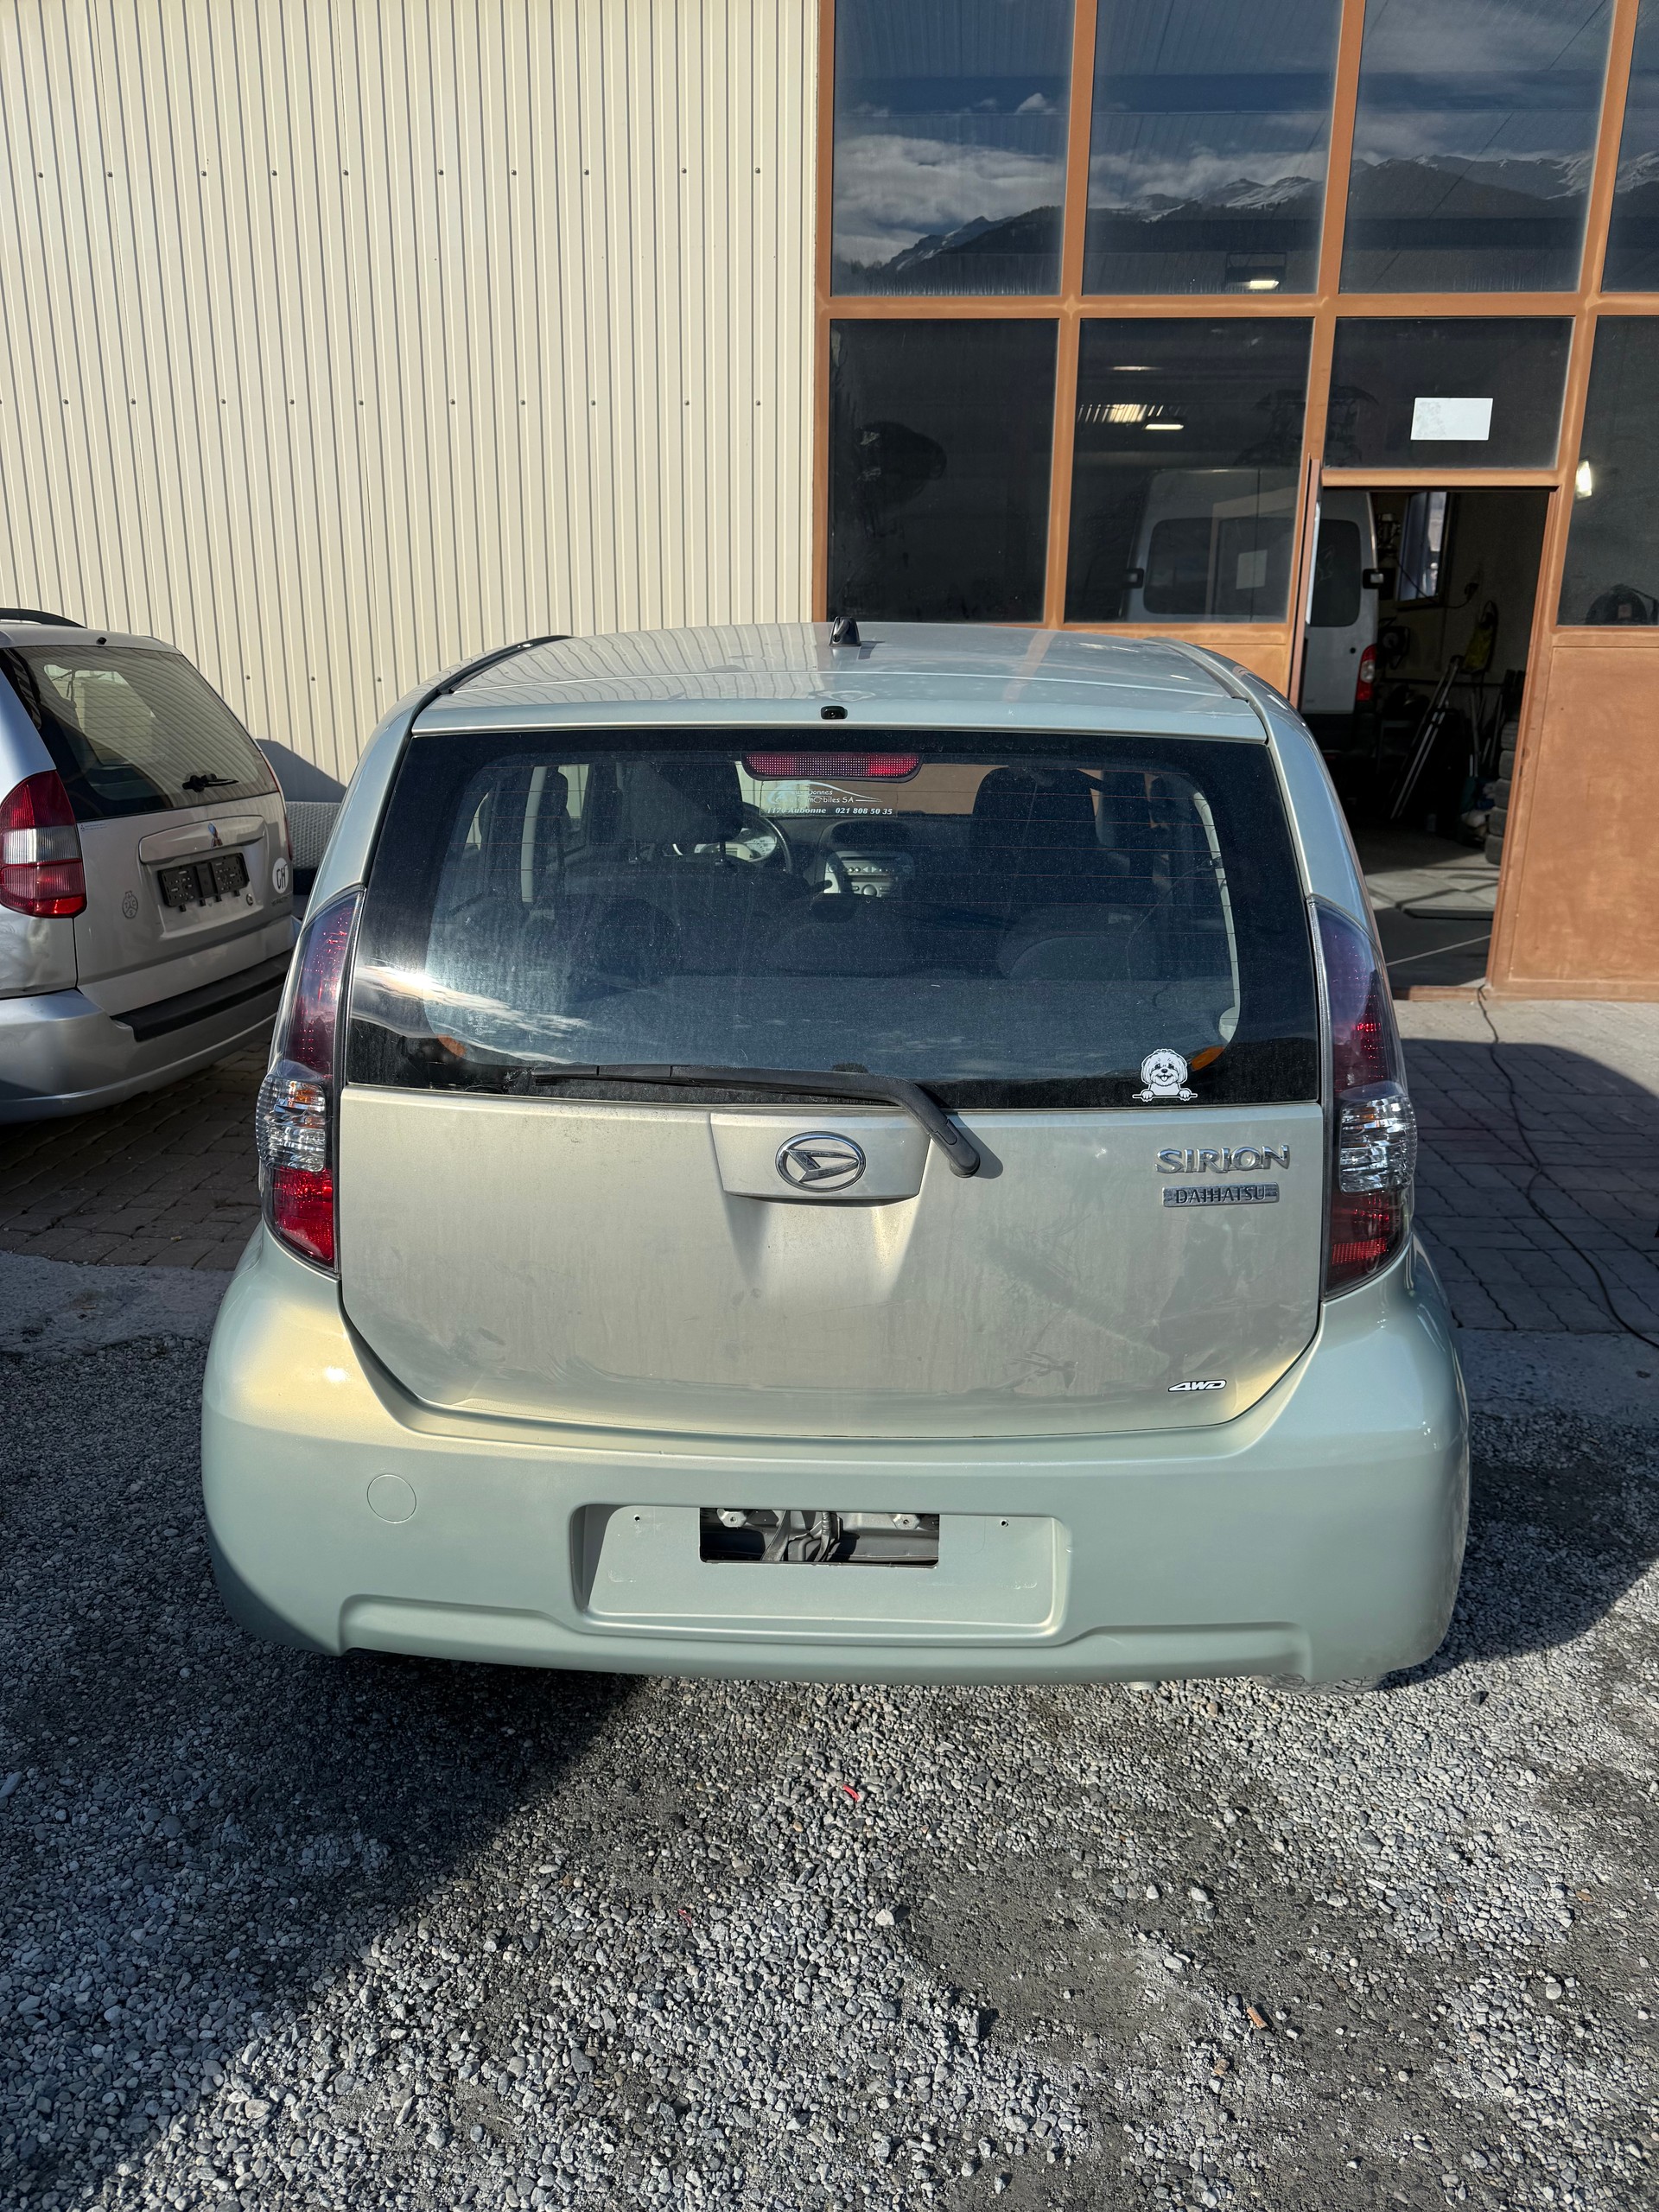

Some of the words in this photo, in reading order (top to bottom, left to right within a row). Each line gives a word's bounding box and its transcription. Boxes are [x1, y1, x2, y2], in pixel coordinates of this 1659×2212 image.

[276, 863, 287, 889] CH
[1155, 1145, 1290, 1173] SIRION
[1175, 1185, 1266, 1204] DAIHATSU
[1168, 1379, 1226, 1392] 4WD
